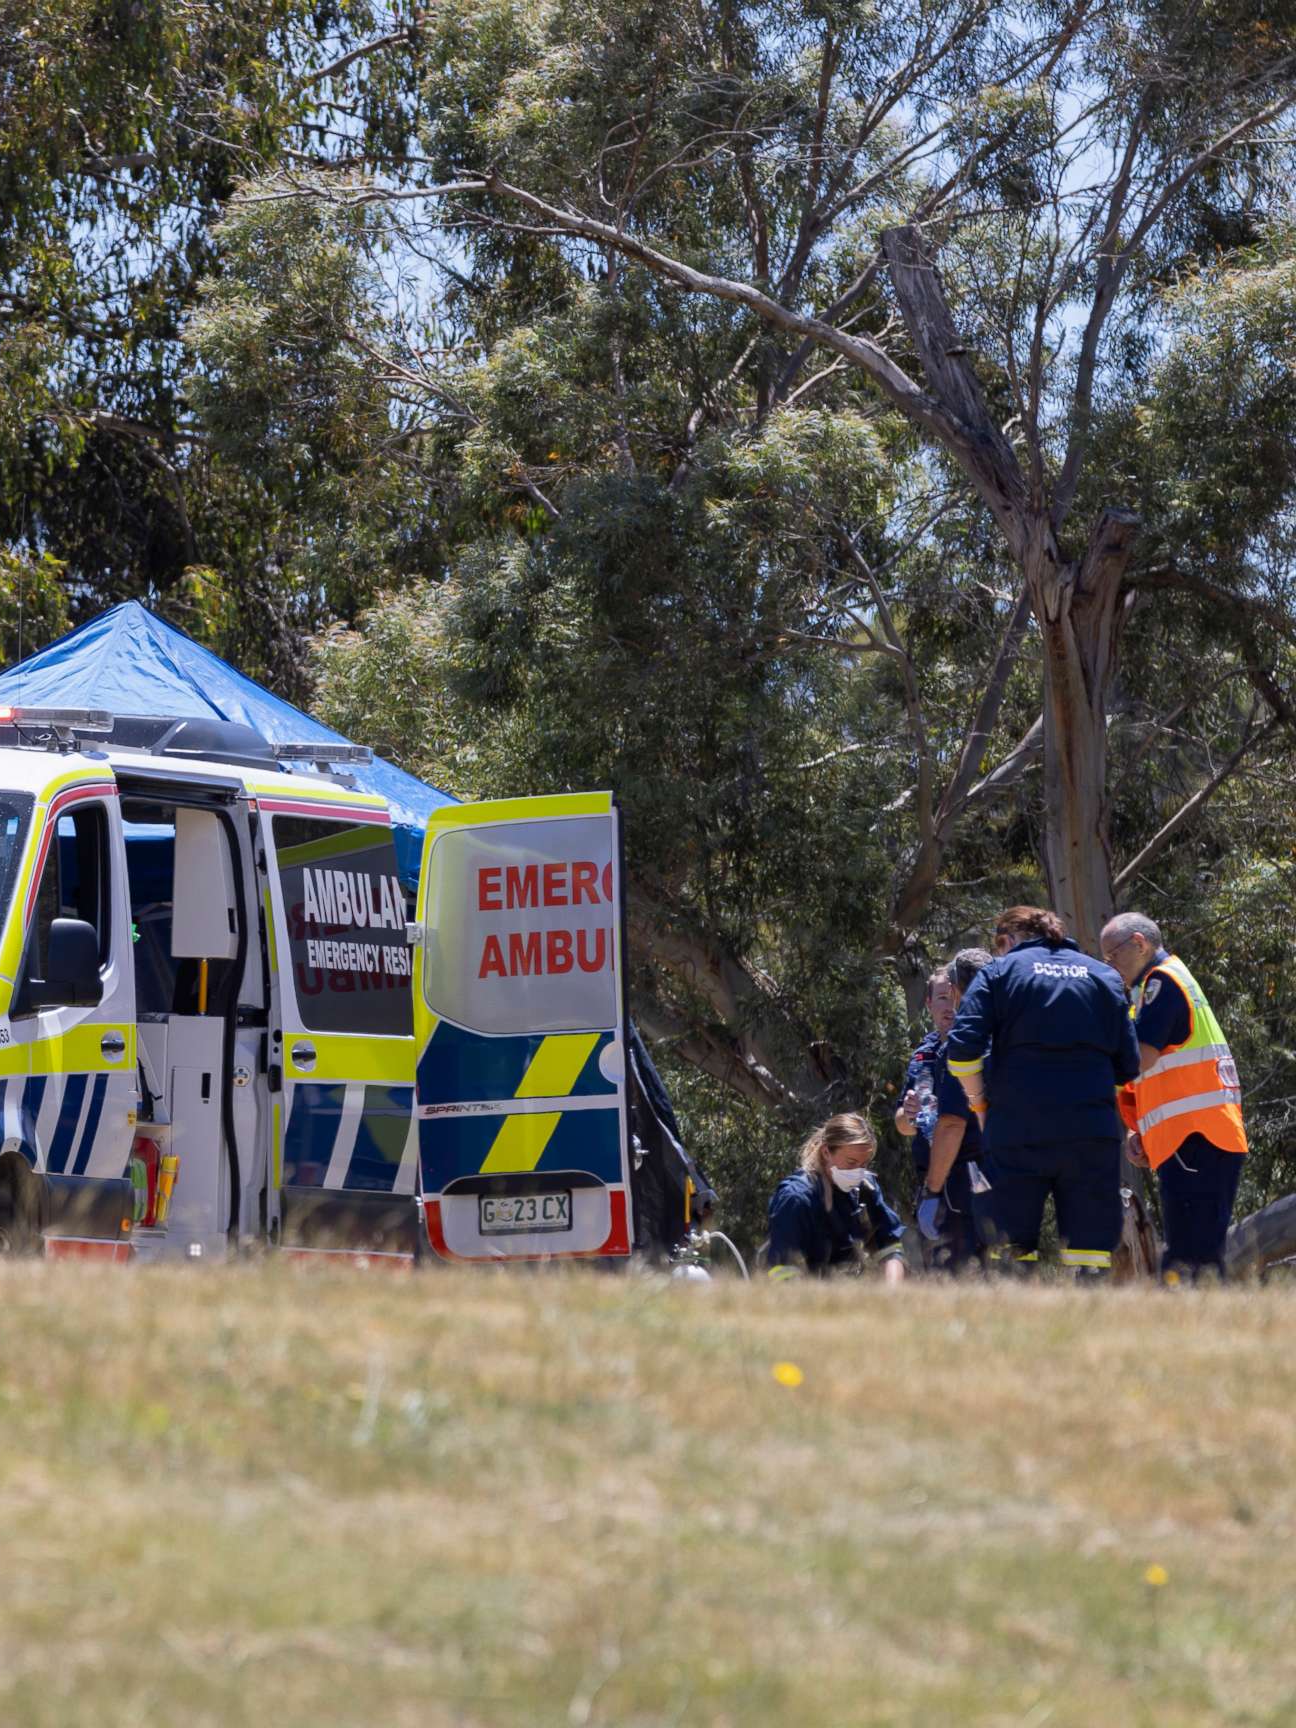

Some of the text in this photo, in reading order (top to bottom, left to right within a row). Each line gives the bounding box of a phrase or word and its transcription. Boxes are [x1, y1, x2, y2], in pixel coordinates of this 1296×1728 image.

[306, 939, 381, 973] EMERGENCY
[478, 928, 615, 979] AMBU
[1033, 962, 1089, 978] DOCTOR
[514, 1198, 537, 1222] 23
[543, 1196, 568, 1220] CX
